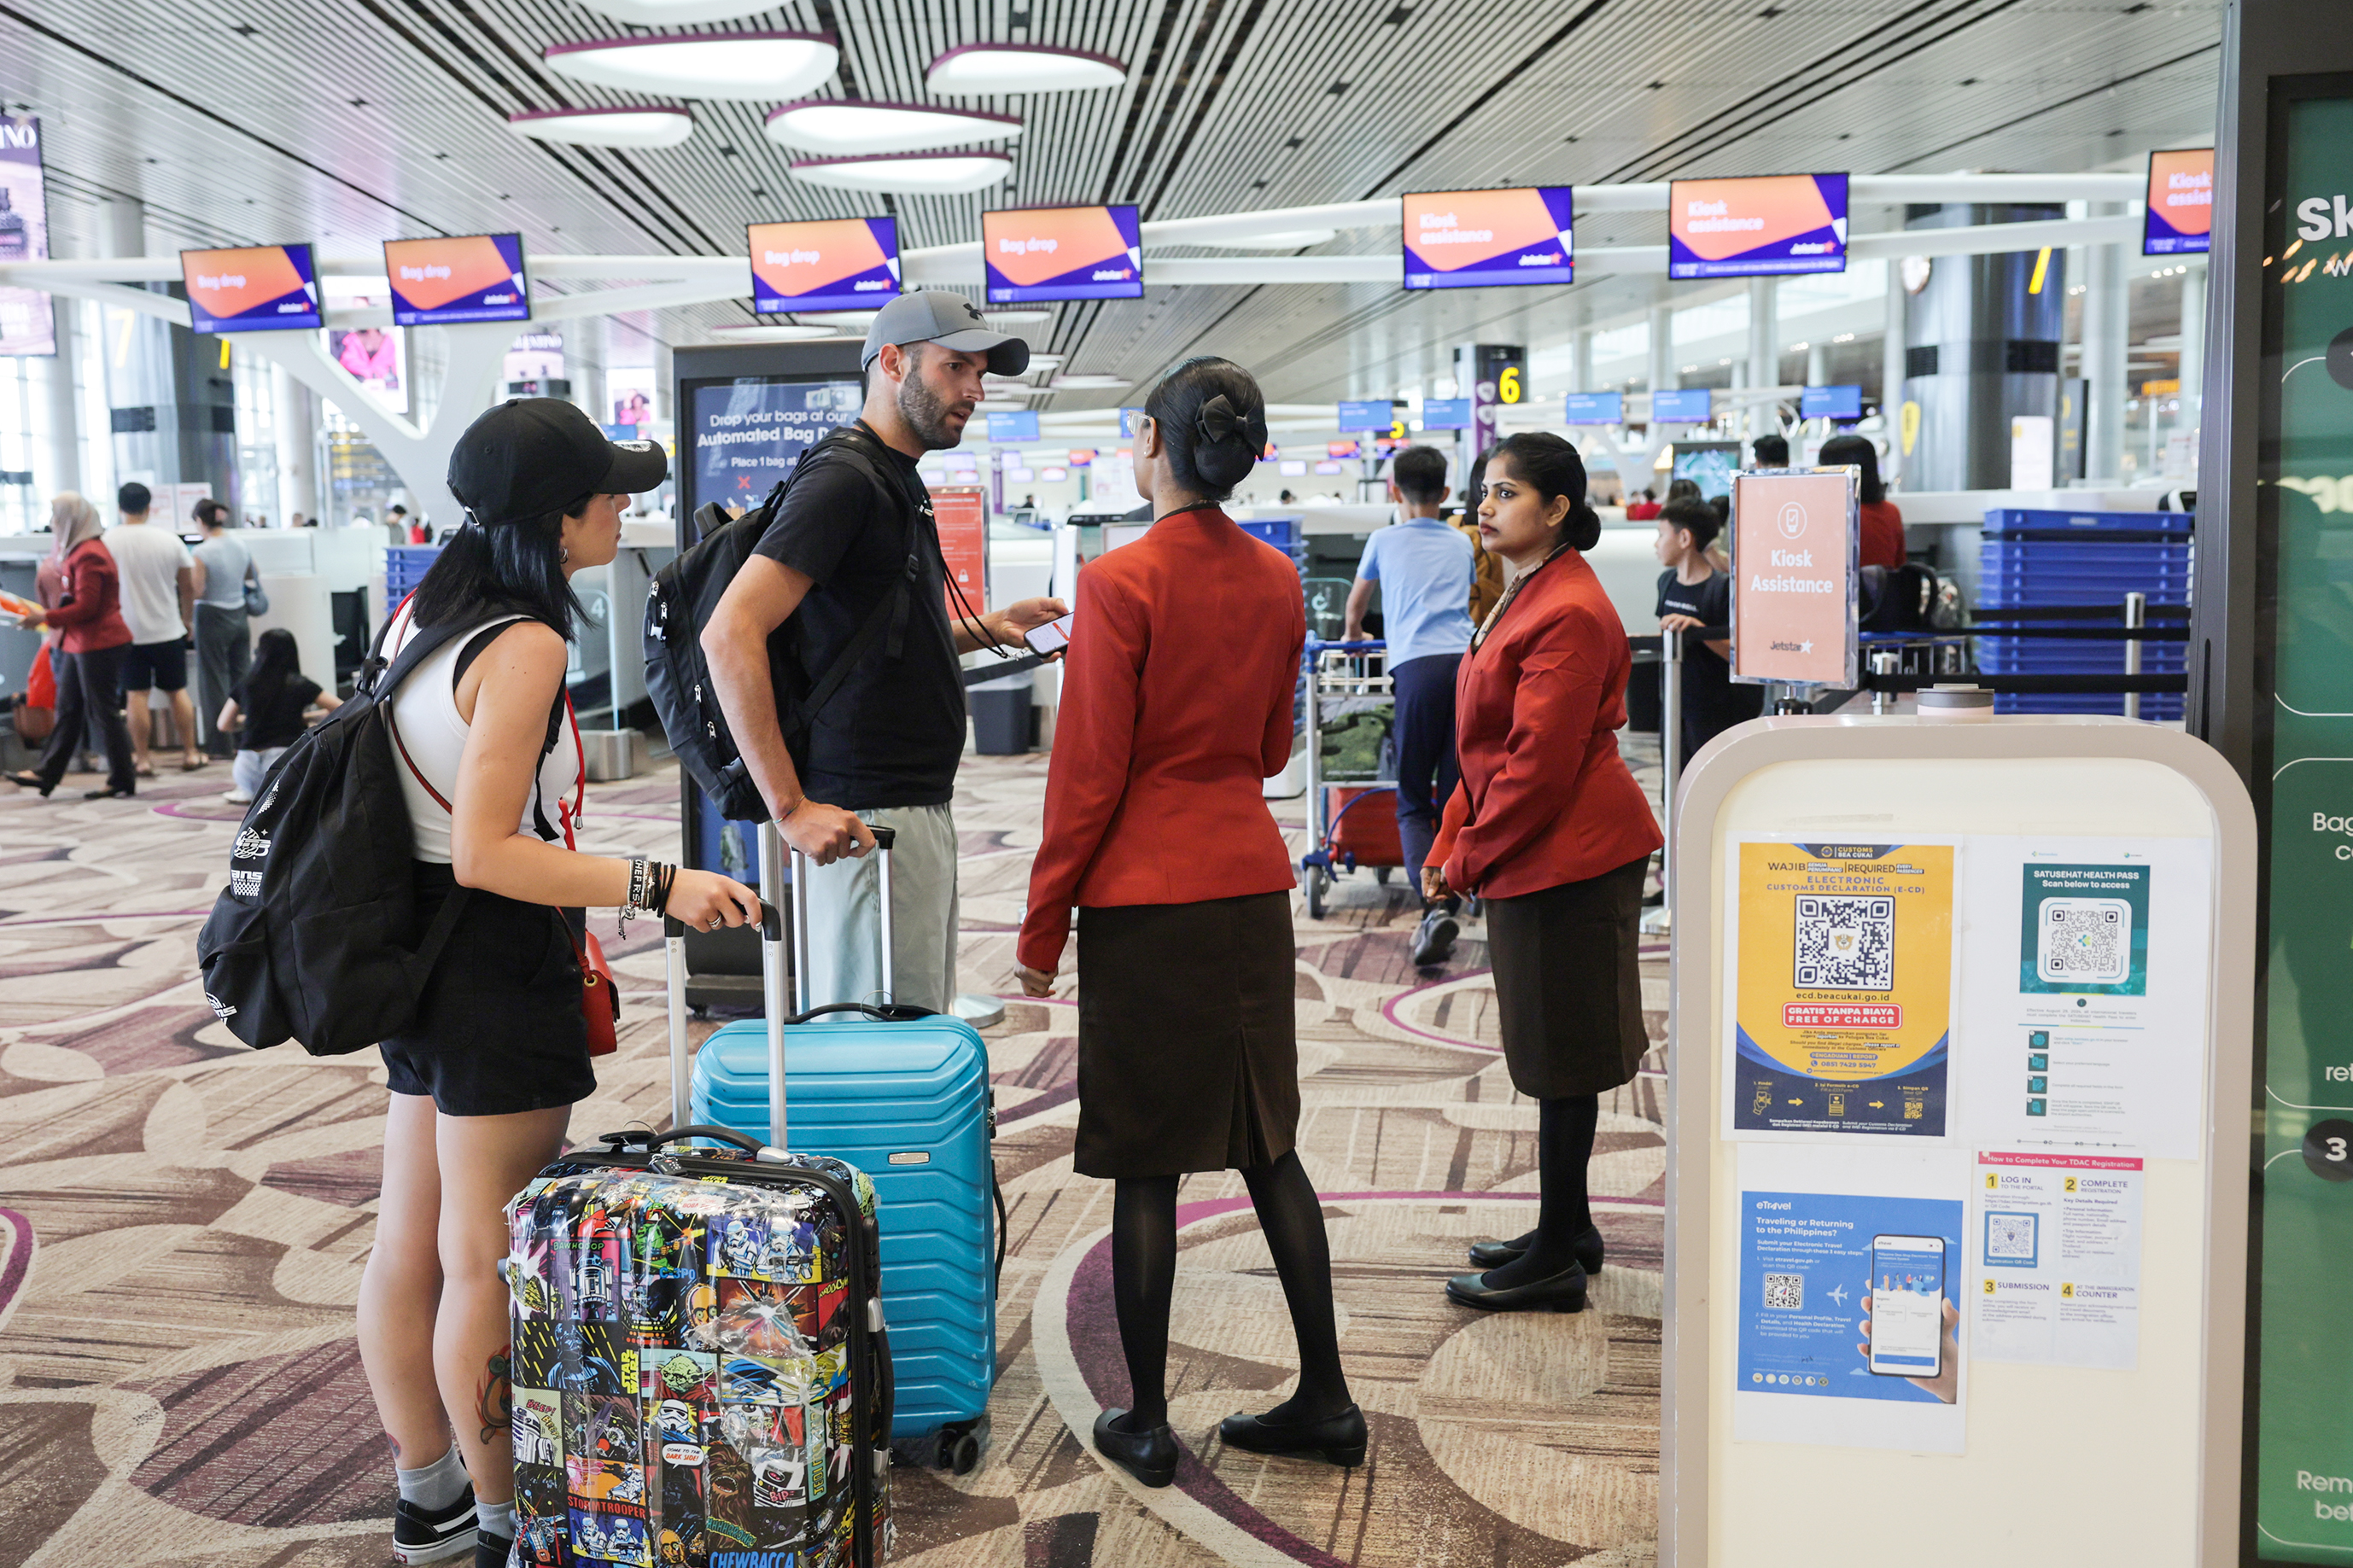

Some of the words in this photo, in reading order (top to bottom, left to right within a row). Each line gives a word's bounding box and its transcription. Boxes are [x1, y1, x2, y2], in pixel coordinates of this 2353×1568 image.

[2169, 171, 2212, 189] Kiosk
[1687, 200, 1728, 217] Kiosk
[1420, 213, 1457, 229] Kiosk
[1687, 216, 1765, 234] assistance
[1420, 227, 1493, 245] assistance
[1000, 238, 1025, 257] Bag
[1026, 237, 1058, 254] drop
[765, 250, 790, 267] Bag
[790, 248, 820, 265] drop
[197, 275, 219, 290] Bag
[220, 273, 247, 289] drop
[400, 265, 423, 282] Bag
[424, 265, 451, 280] drop
[1499, 367, 1521, 404] 6
[709, 414, 742, 428] Drop
[744, 413, 773, 426] your
[774, 410, 809, 425] bags
[810, 410, 825, 423] at
[826, 411, 849, 423] our
[697, 427, 780, 448] Automated
[783, 426, 814, 444] Bag
[731, 456, 758, 468] Place
[759, 456, 765, 467] 1
[766, 457, 785, 469] bag
[1771, 549, 1813, 568] Kiosk
[1750, 574, 1834, 593] Assistance
[1770, 640, 1802, 652] Jetstar
[2335, 844, 2353, 860] c
[1767, 862, 1806, 871] WAJIB
[1848, 864, 1895, 874] REQUIRED
[231, 870, 263, 880] ans
[1807, 876, 1884, 884] ELECTRONIC
[2034, 870, 2082, 878] SATUSEHAT
[2083, 871, 2116, 879] HEALTH
[2117, 871, 2140, 880] PASS
[1894, 886, 1924, 895] (E-CD)
[1796, 992, 1889, 1002] ecd.beacukai.go.id
[1844, 1016, 1895, 1024] CHARGE
[2325, 1137, 2347, 1162] 3
[1988, 1175, 1994, 1186] 1
[2066, 1179, 2075, 1191] 2
[2081, 1180, 2128, 1188] COMPLETE
[1756, 1217, 1796, 1227] Traveling
[1810, 1219, 1854, 1230] Returning
[1784, 1227, 1837, 1237] Philippines?
[1985, 1281, 1994, 1292] 3
[1998, 1281, 2050, 1291] SUBMISSION
[2063, 1285, 2071, 1296] 4
[621, 1349, 631, 1394] STAR
[769, 1490, 789, 1502] BIP
[567, 1495, 646, 1518] STORMTROOPER
[709, 1551, 794, 1568] CHEWBACCA
